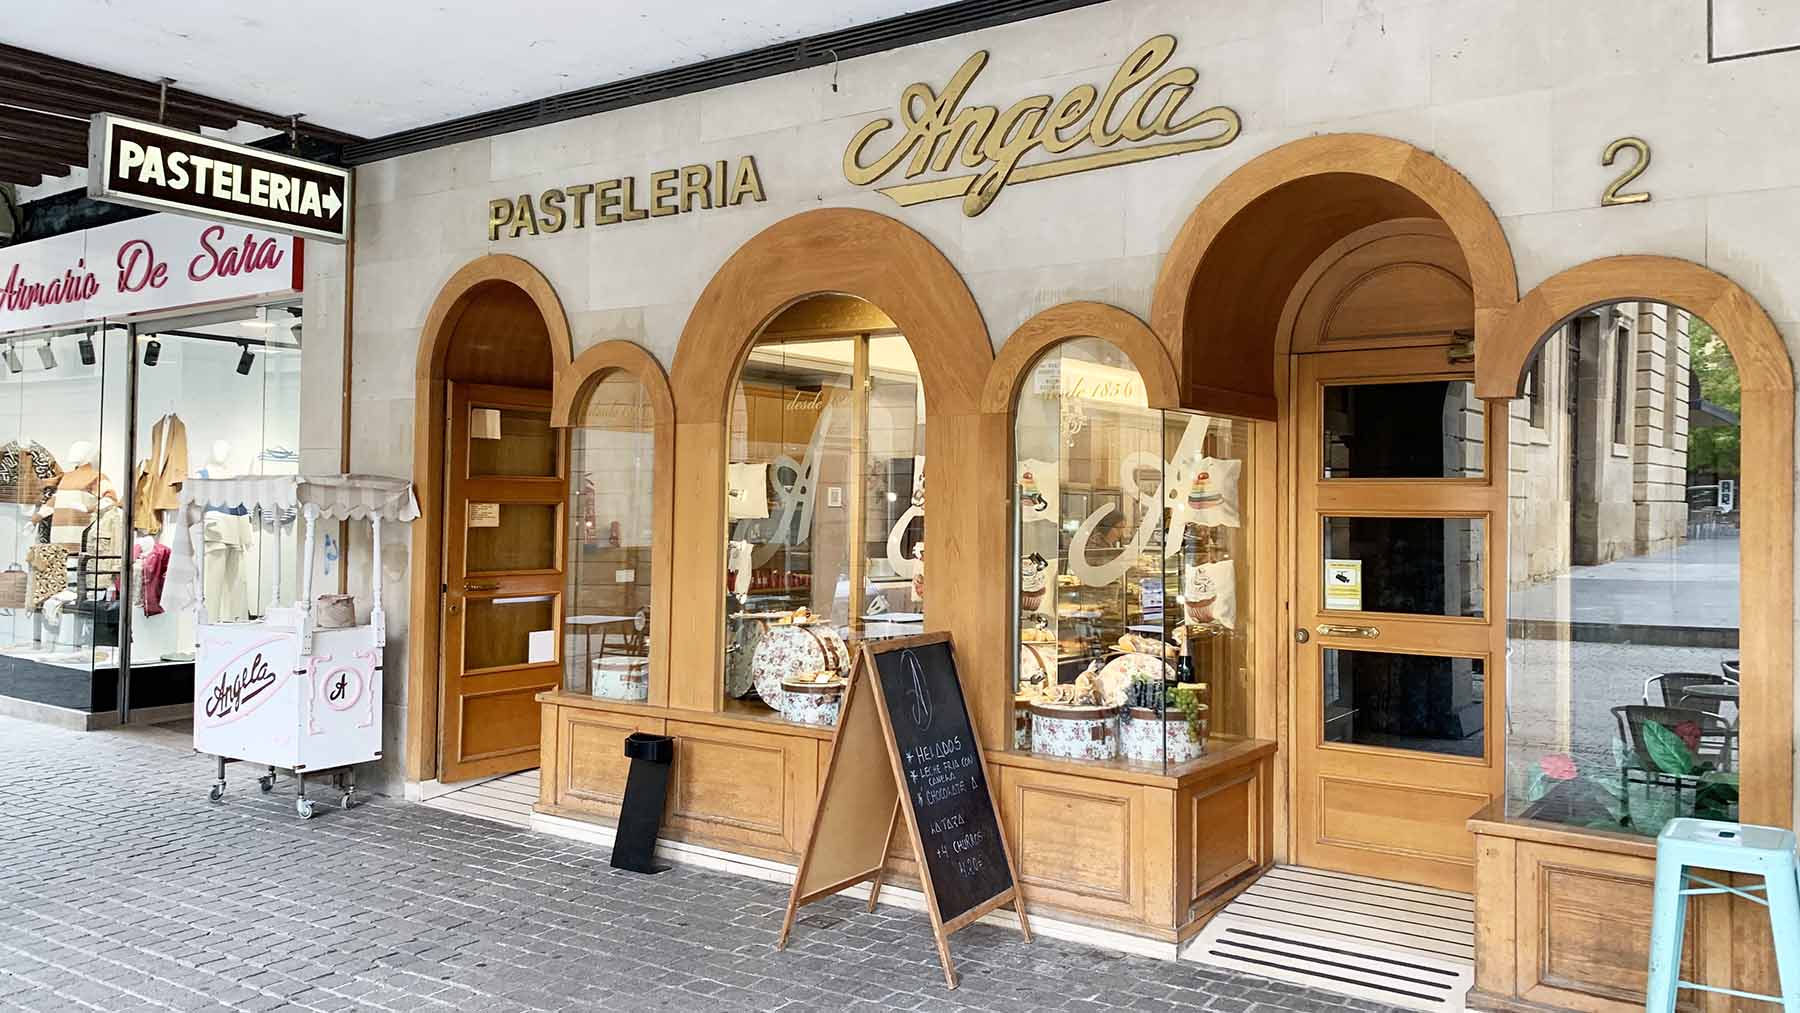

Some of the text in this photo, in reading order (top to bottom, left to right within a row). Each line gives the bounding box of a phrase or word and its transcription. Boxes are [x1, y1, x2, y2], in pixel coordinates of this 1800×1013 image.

[843, 34, 1241, 218] Angela
[118, 139, 323, 218] PASTELERIA
[488, 155, 768, 241] PASTELERIA
[1602, 137, 1652, 207] 2
[0, 225, 285, 312] Armario De Sara
[786, 391, 823, 411] desde
[205, 653, 276, 718] Angela
[329, 673, 347, 700] A
[915, 736, 961, 765] HELADOS
